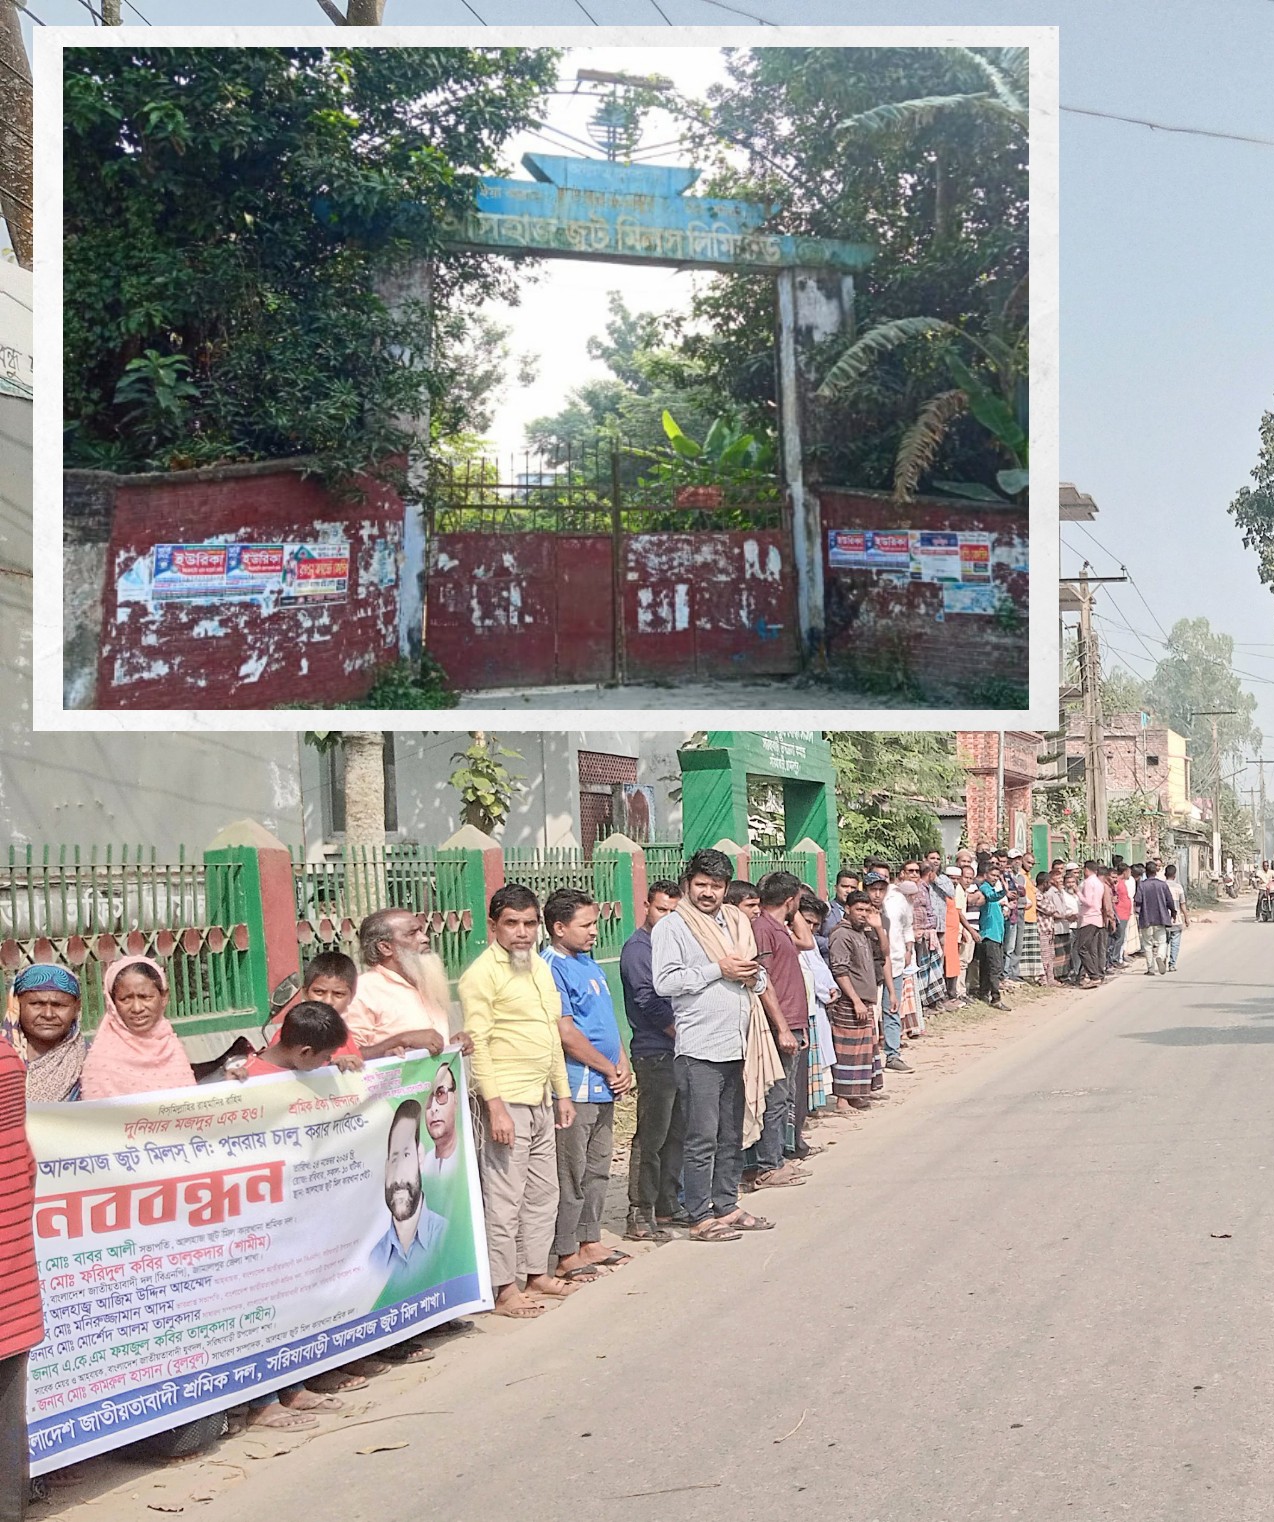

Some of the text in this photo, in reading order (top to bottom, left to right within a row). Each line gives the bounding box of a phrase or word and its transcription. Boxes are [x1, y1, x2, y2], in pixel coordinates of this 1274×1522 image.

[38, 1153, 110, 1178] আলহাজ
[115, 1144, 141, 1172] জুট
[144, 1141, 189, 1164] মিলস্
[218, 1131, 266, 1157] পুনরায়
[272, 1126, 302, 1148] চালু
[304, 1120, 330, 1140] করার
[124, 1117, 172, 1139] দুনিয়ার
[174, 1113, 213, 1132] মজদুর
[217, 1111, 236, 1124] এক
[35, 1160, 286, 1239] নববন্ধন
[45, 1255, 69, 1271] মোঃ
[73, 1249, 102, 1265] বাবর
[106, 1239, 137, 1258] আলী
[50, 1274, 75, 1289] মোঃ
[80, 1261, 125, 1282] ফরিদুল
[130, 1255, 163, 1271] কবির
[167, 1244, 224, 1266] তালুকদার
[228, 1233, 271, 1258] (শামীম)
[53, 1300, 175, 1338] মোঃ মনিরুজ্জামান আদম
[95, 1292, 133, 1310] আজিম
[136, 1284, 167, 1300] উদ্দিন
[31, 1304, 277, 1381] জনাব এ.কে.এম ফয়জুল কবির তালুকদার (শাহীন)
[57, 1340, 75, 1355] মোঃ
[77, 1326, 113, 1348] মোর্শেদ
[117, 1322, 149, 1337] আলম
[152, 1309, 202, 1329] তালুকদার
[28, 1419, 76, 1456] লাদেশ
[78, 1383, 180, 1432] জাতীয়তাবাদী
[183, 1369, 229, 1399] শ্রমিক
[234, 1362, 263, 1383] দল,
[266, 1336, 330, 1373] সরিষাবাড়ী
[331, 1318, 378, 1348] আলহাজ
[380, 1308, 399, 1333] জুট
[399, 1302, 418, 1323] মিল
[37, 1395, 64, 1412] জনাব
[67, 1388, 87, 1402] মোঃ
[89, 1373, 127, 1394] কামরুল
[129, 1362, 163, 1382] হাসান
[166, 1350, 210, 1376] (বুলবুল)
